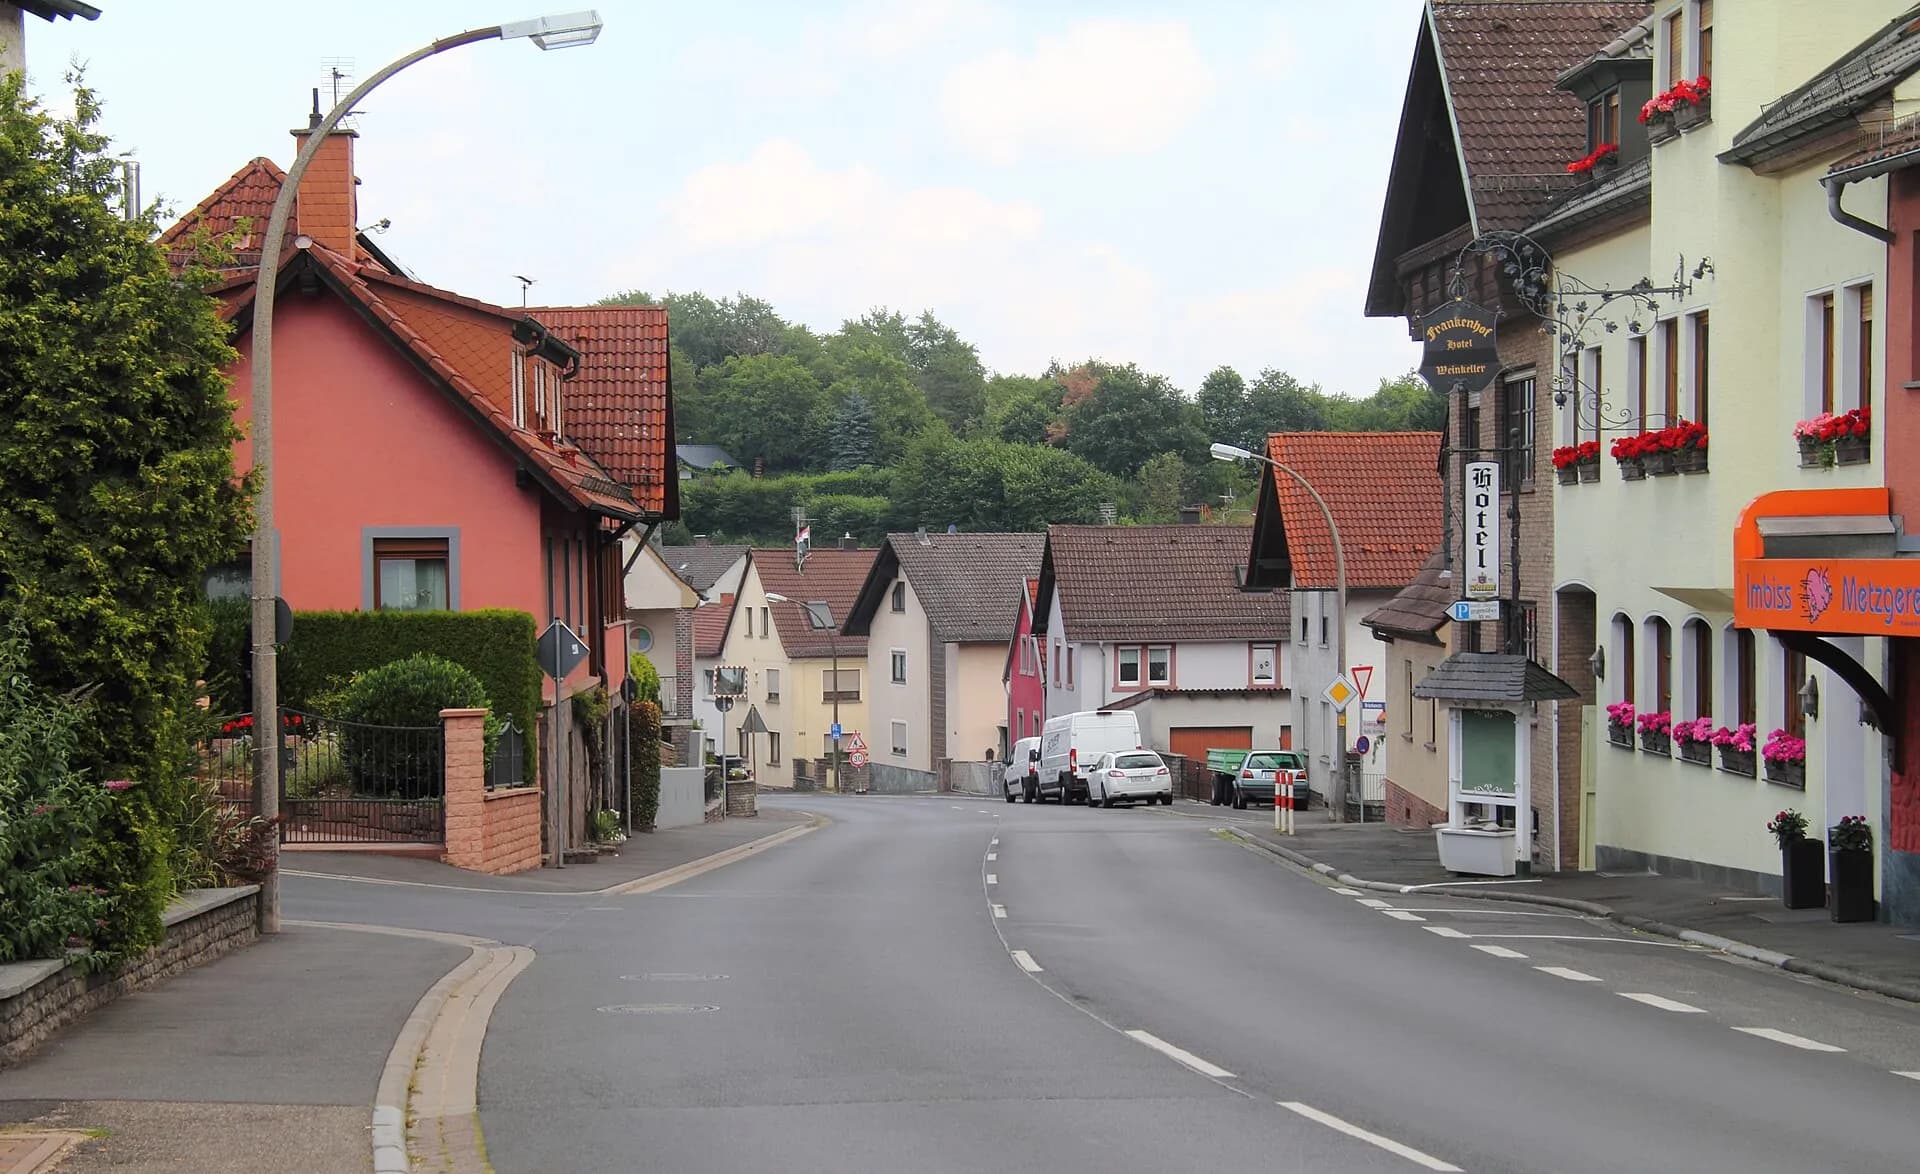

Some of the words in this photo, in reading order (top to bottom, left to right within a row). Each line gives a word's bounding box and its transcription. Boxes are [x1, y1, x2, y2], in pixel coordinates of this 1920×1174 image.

[1427, 317, 1493, 341] Frankenhof
[1447, 339, 1472, 351] Hotel
[1436, 364, 1486, 376] Weinkeller
[1472, 467, 1492, 569] Hotel
[1746, 574, 1792, 610] Imbiss
[1459, 604, 1468, 618] P
[853, 755, 863, 763] 30
